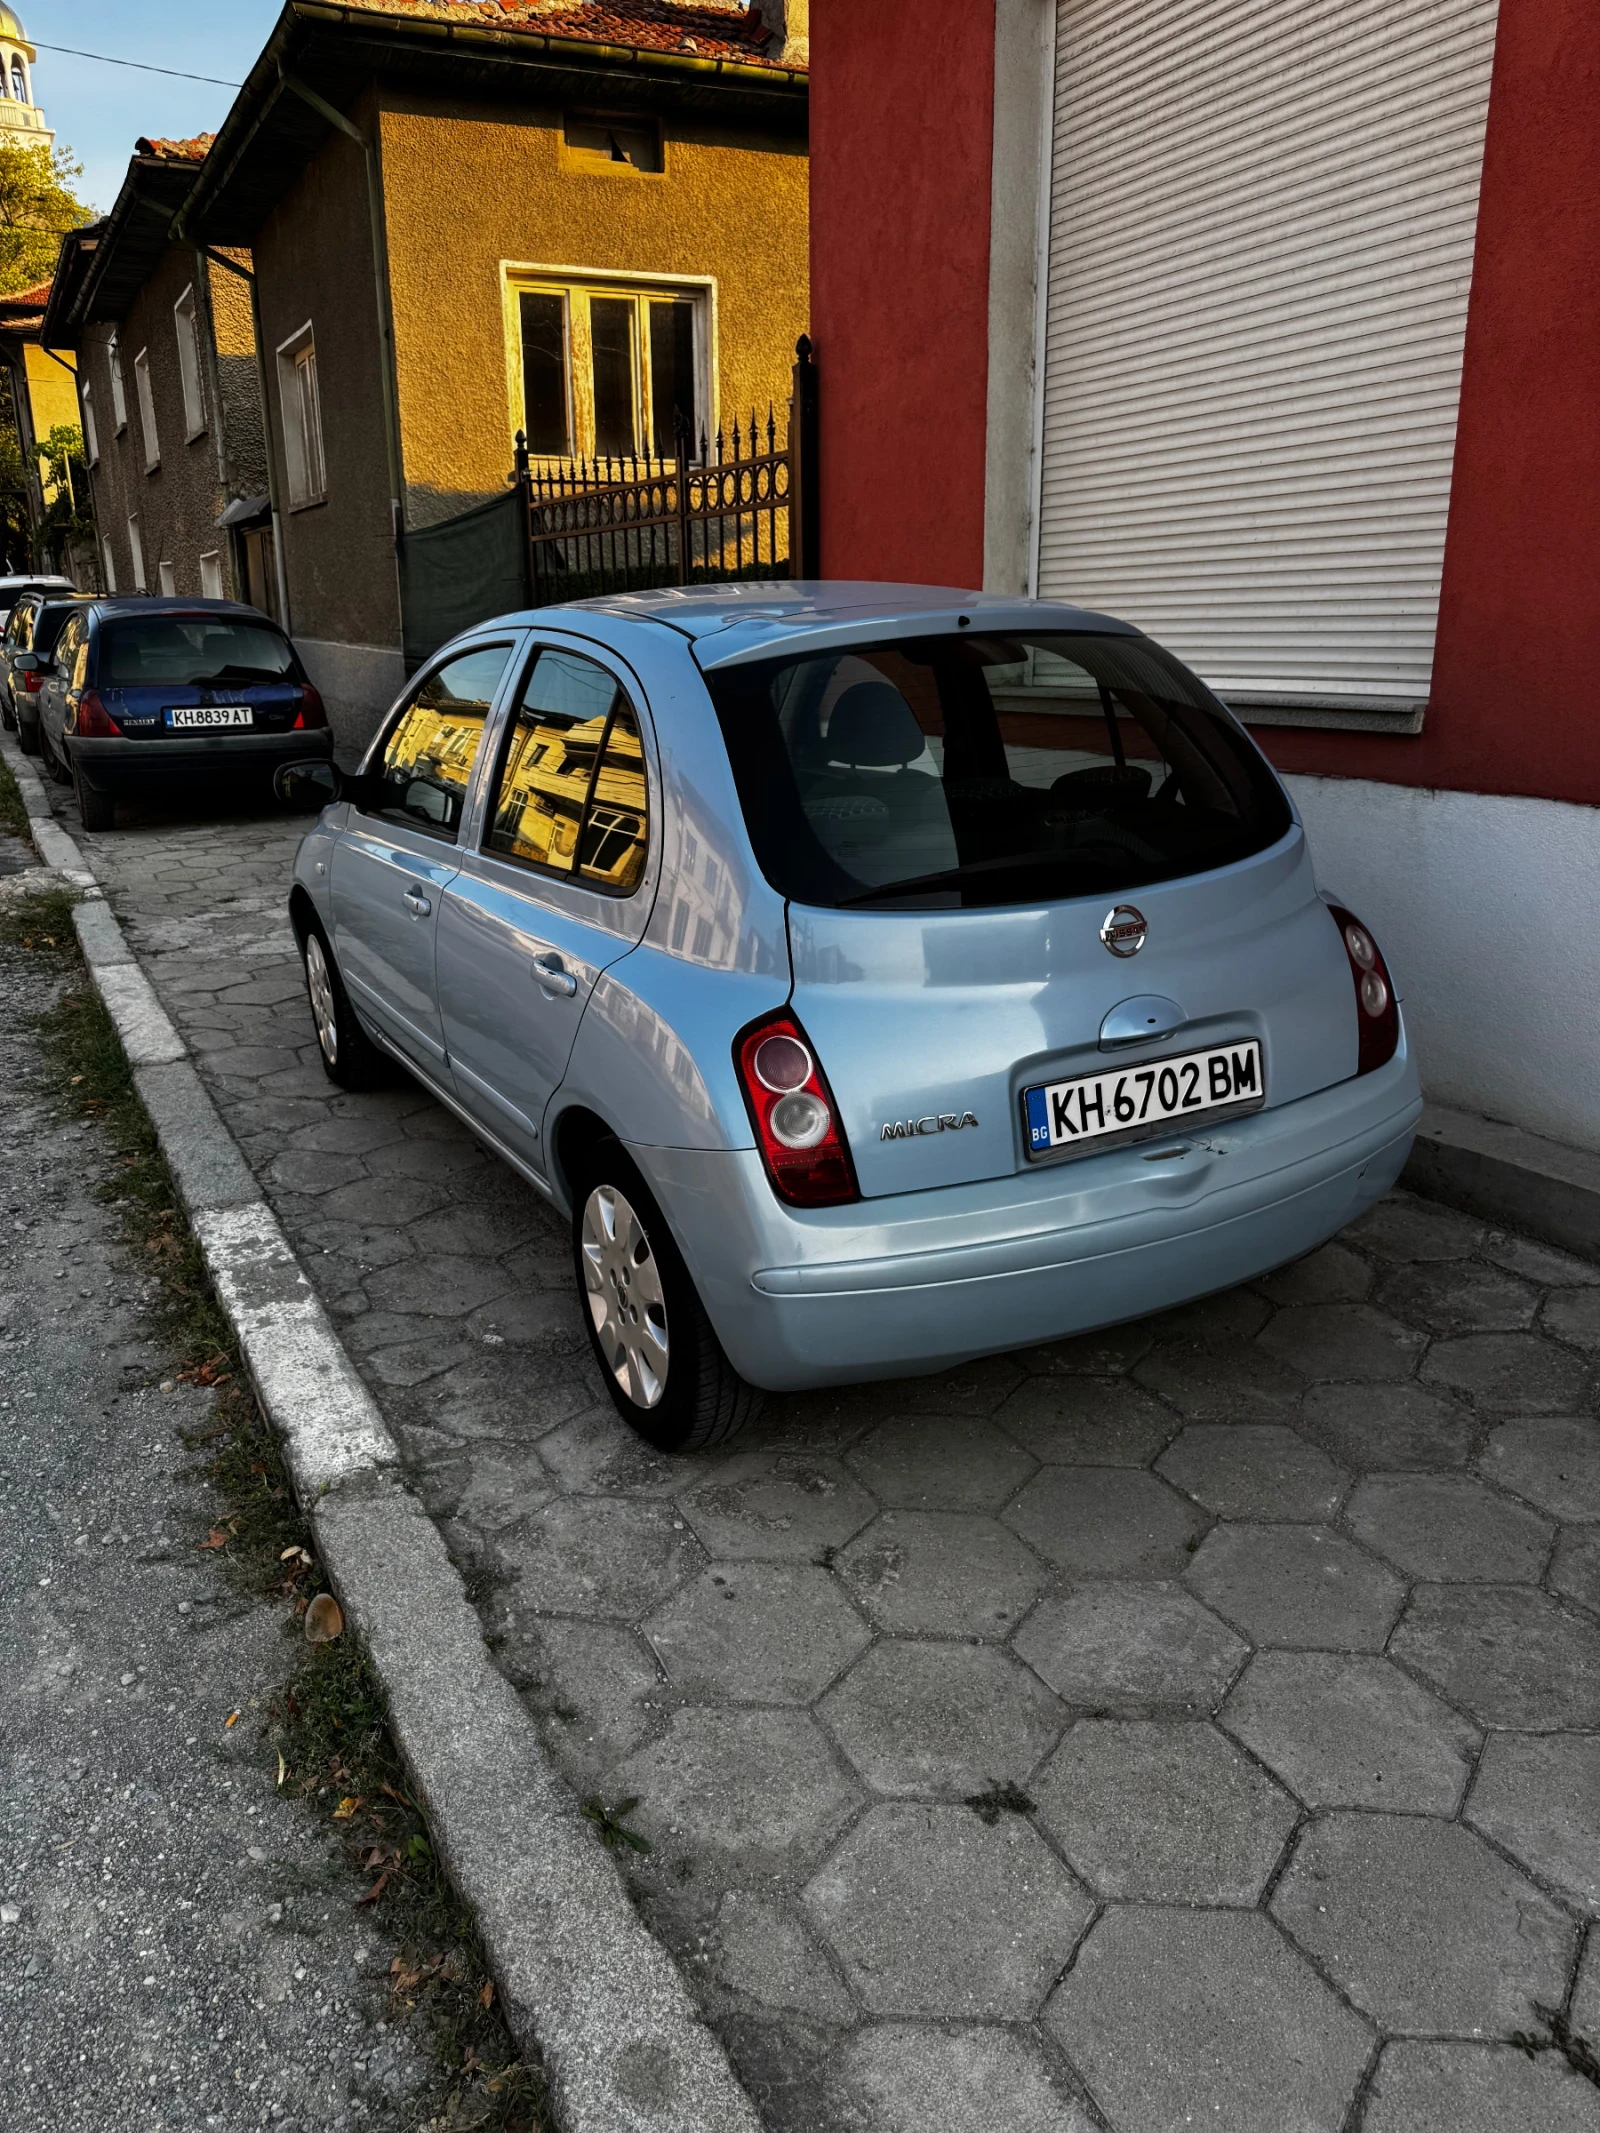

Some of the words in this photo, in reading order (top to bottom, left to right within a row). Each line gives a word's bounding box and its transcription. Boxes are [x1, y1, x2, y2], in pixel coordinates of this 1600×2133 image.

[123, 718, 156, 726] RENAULT
[1106, 925, 1146, 940] NISSAN
[880, 1111, 979, 1141] MICRA
[1031, 1125, 1048, 1141] BG
